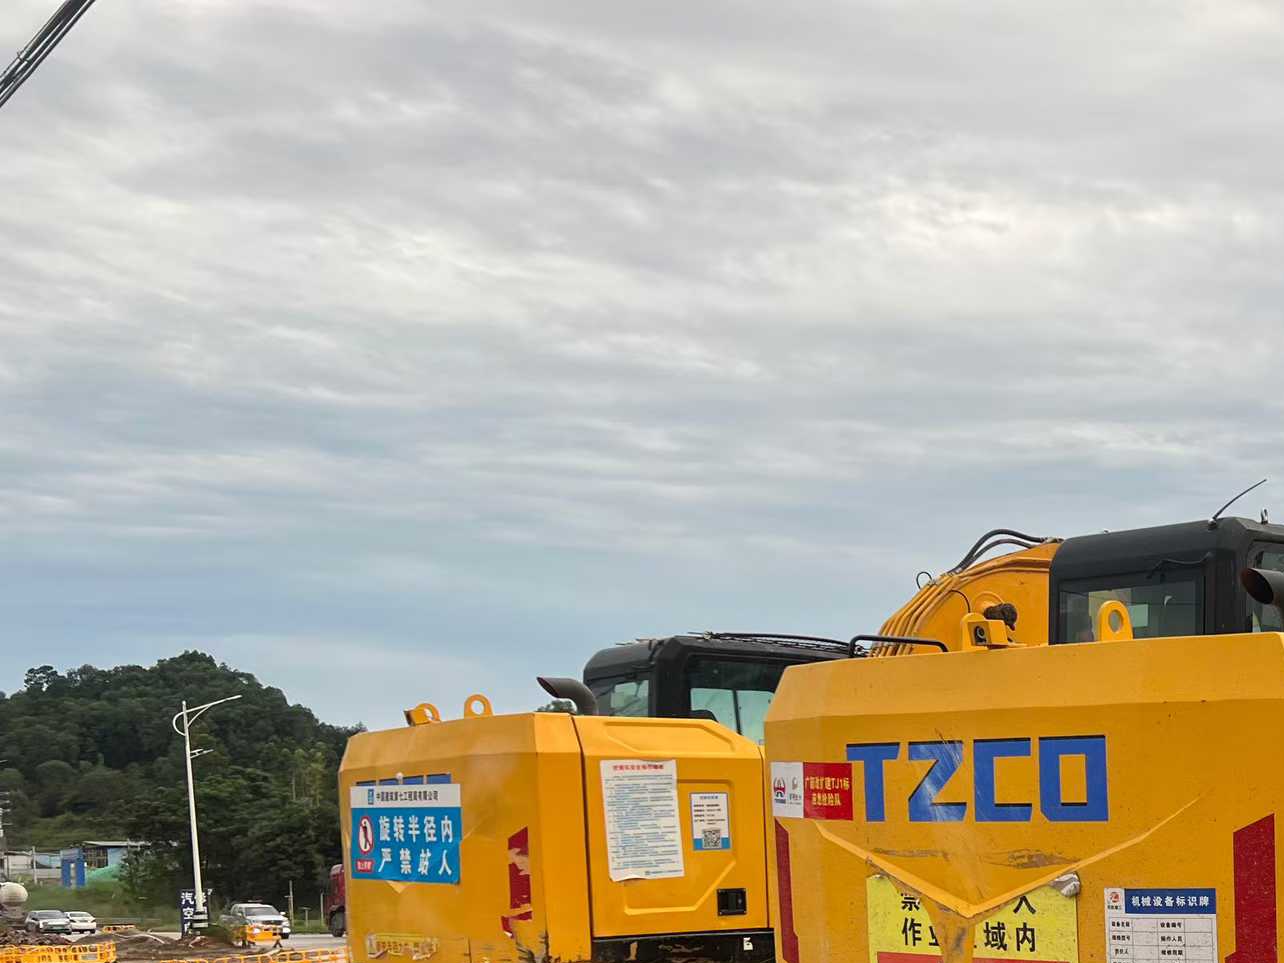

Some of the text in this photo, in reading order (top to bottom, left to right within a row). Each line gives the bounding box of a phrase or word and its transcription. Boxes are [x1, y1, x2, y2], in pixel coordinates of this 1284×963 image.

[845, 735, 1109, 823] TZCO
[379, 815, 453, 843] 旋转半径内
[378, 847, 452, 876] 严禁站人
[1131, 895, 1210, 907] 机械设备标识牌
[902, 918, 1036, 953] 作域内
